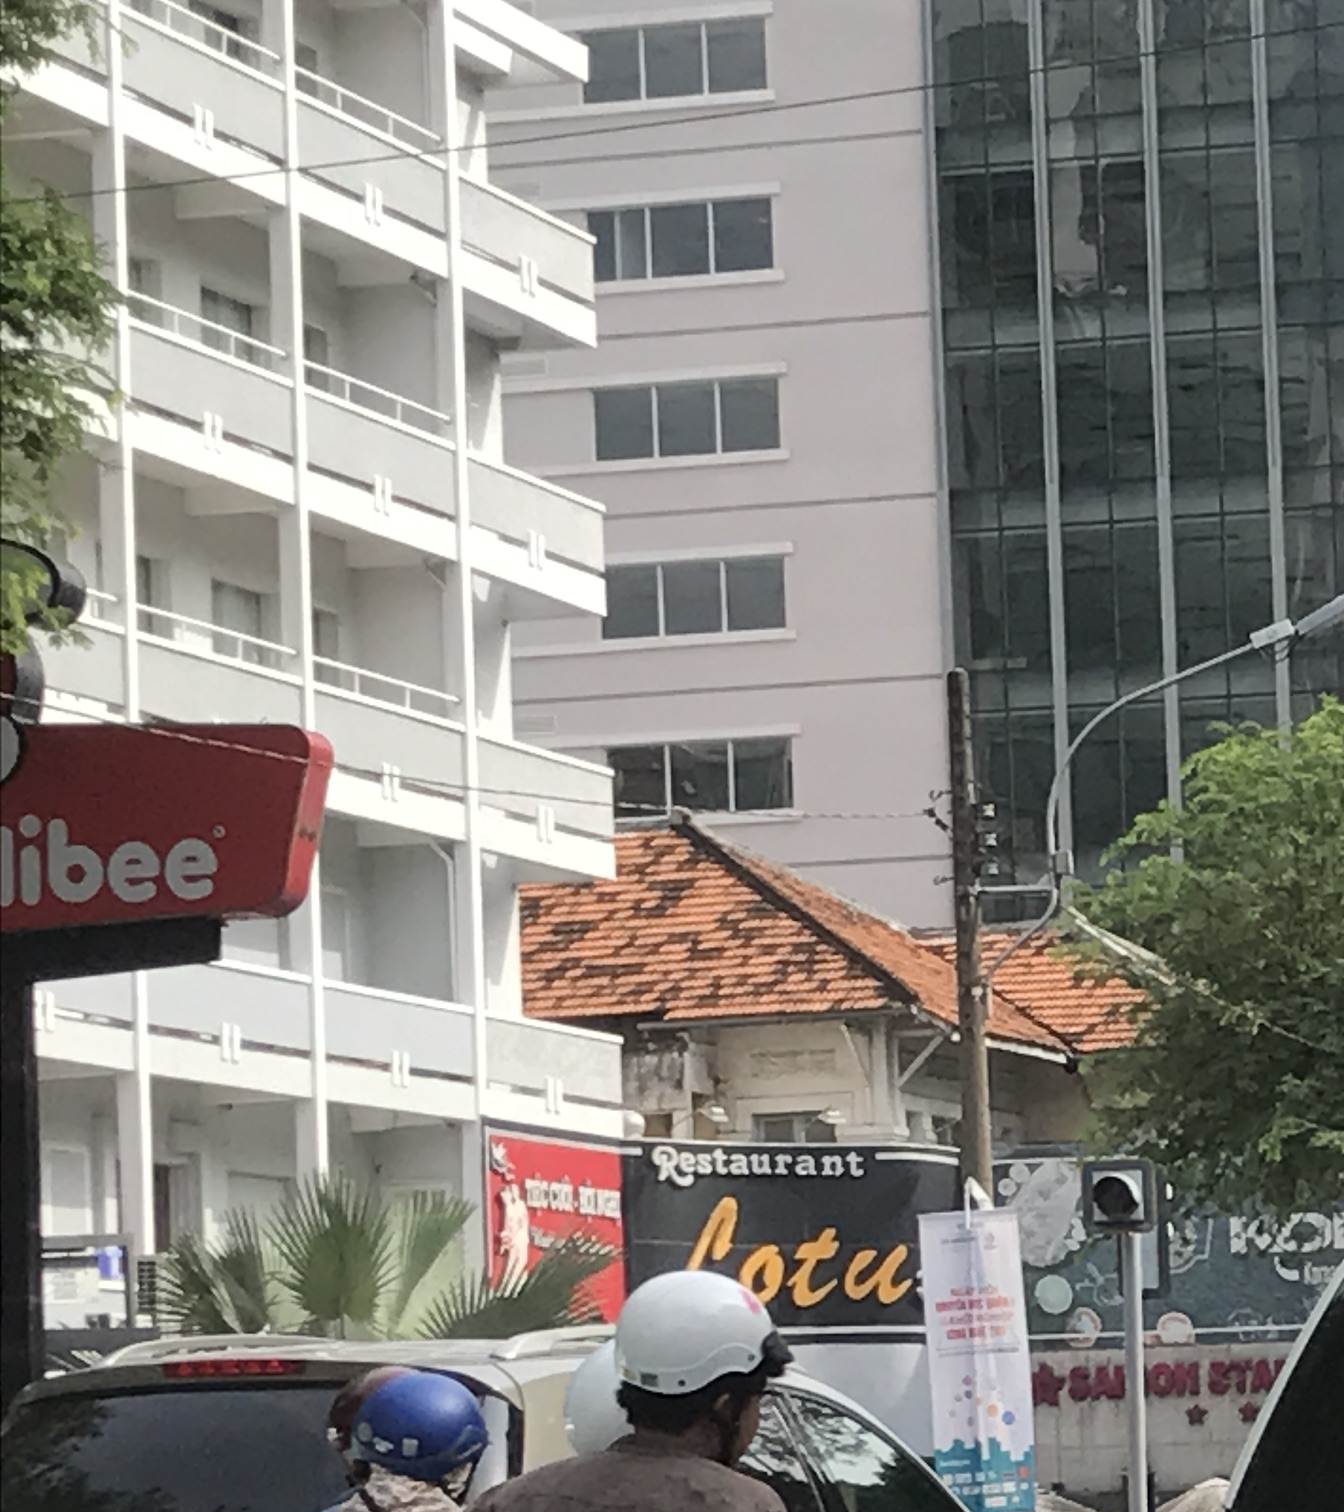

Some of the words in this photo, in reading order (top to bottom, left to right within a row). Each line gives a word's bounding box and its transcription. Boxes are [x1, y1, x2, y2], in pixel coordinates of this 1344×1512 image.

[652, 1145, 865, 1187] Restaurant
[685, 1196, 924, 1308] Lotu
[1068, 1361, 1200, 1401] SAION
